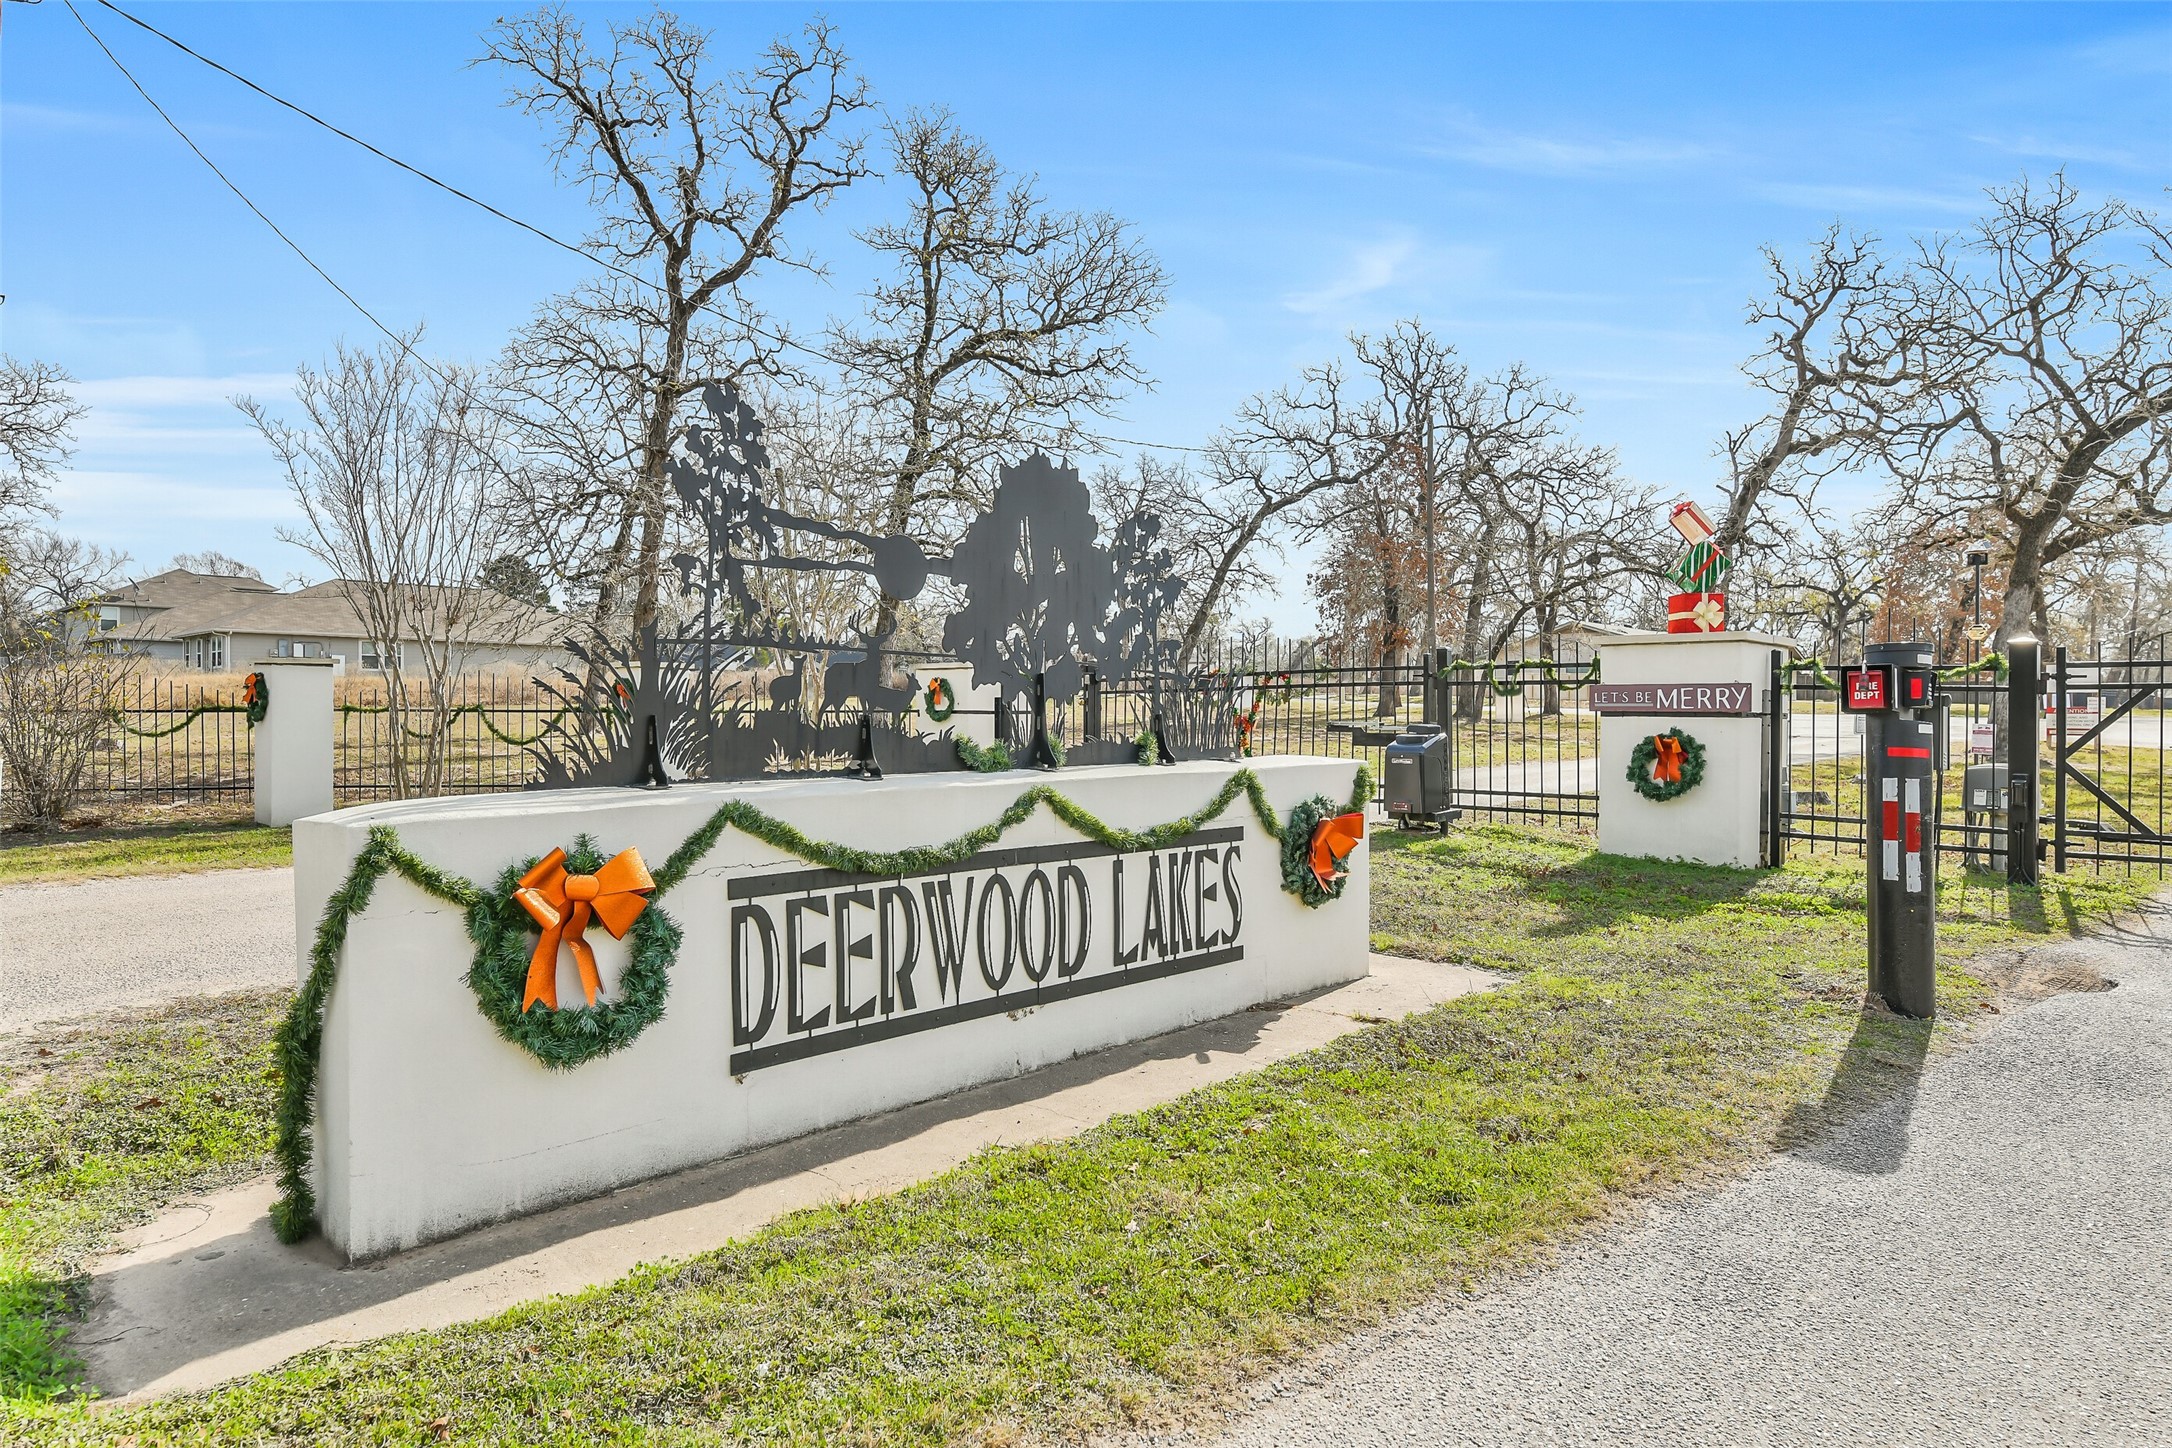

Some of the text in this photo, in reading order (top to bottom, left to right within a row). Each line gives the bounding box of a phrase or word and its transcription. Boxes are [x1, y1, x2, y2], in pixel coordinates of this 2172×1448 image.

[1856, 682, 1878, 690] FE
[1594, 687, 1747, 709] LET'S BE MERRY
[1854, 691, 1880, 700] DEPT
[731, 845, 1242, 1047] DEERWOOD LAKES
